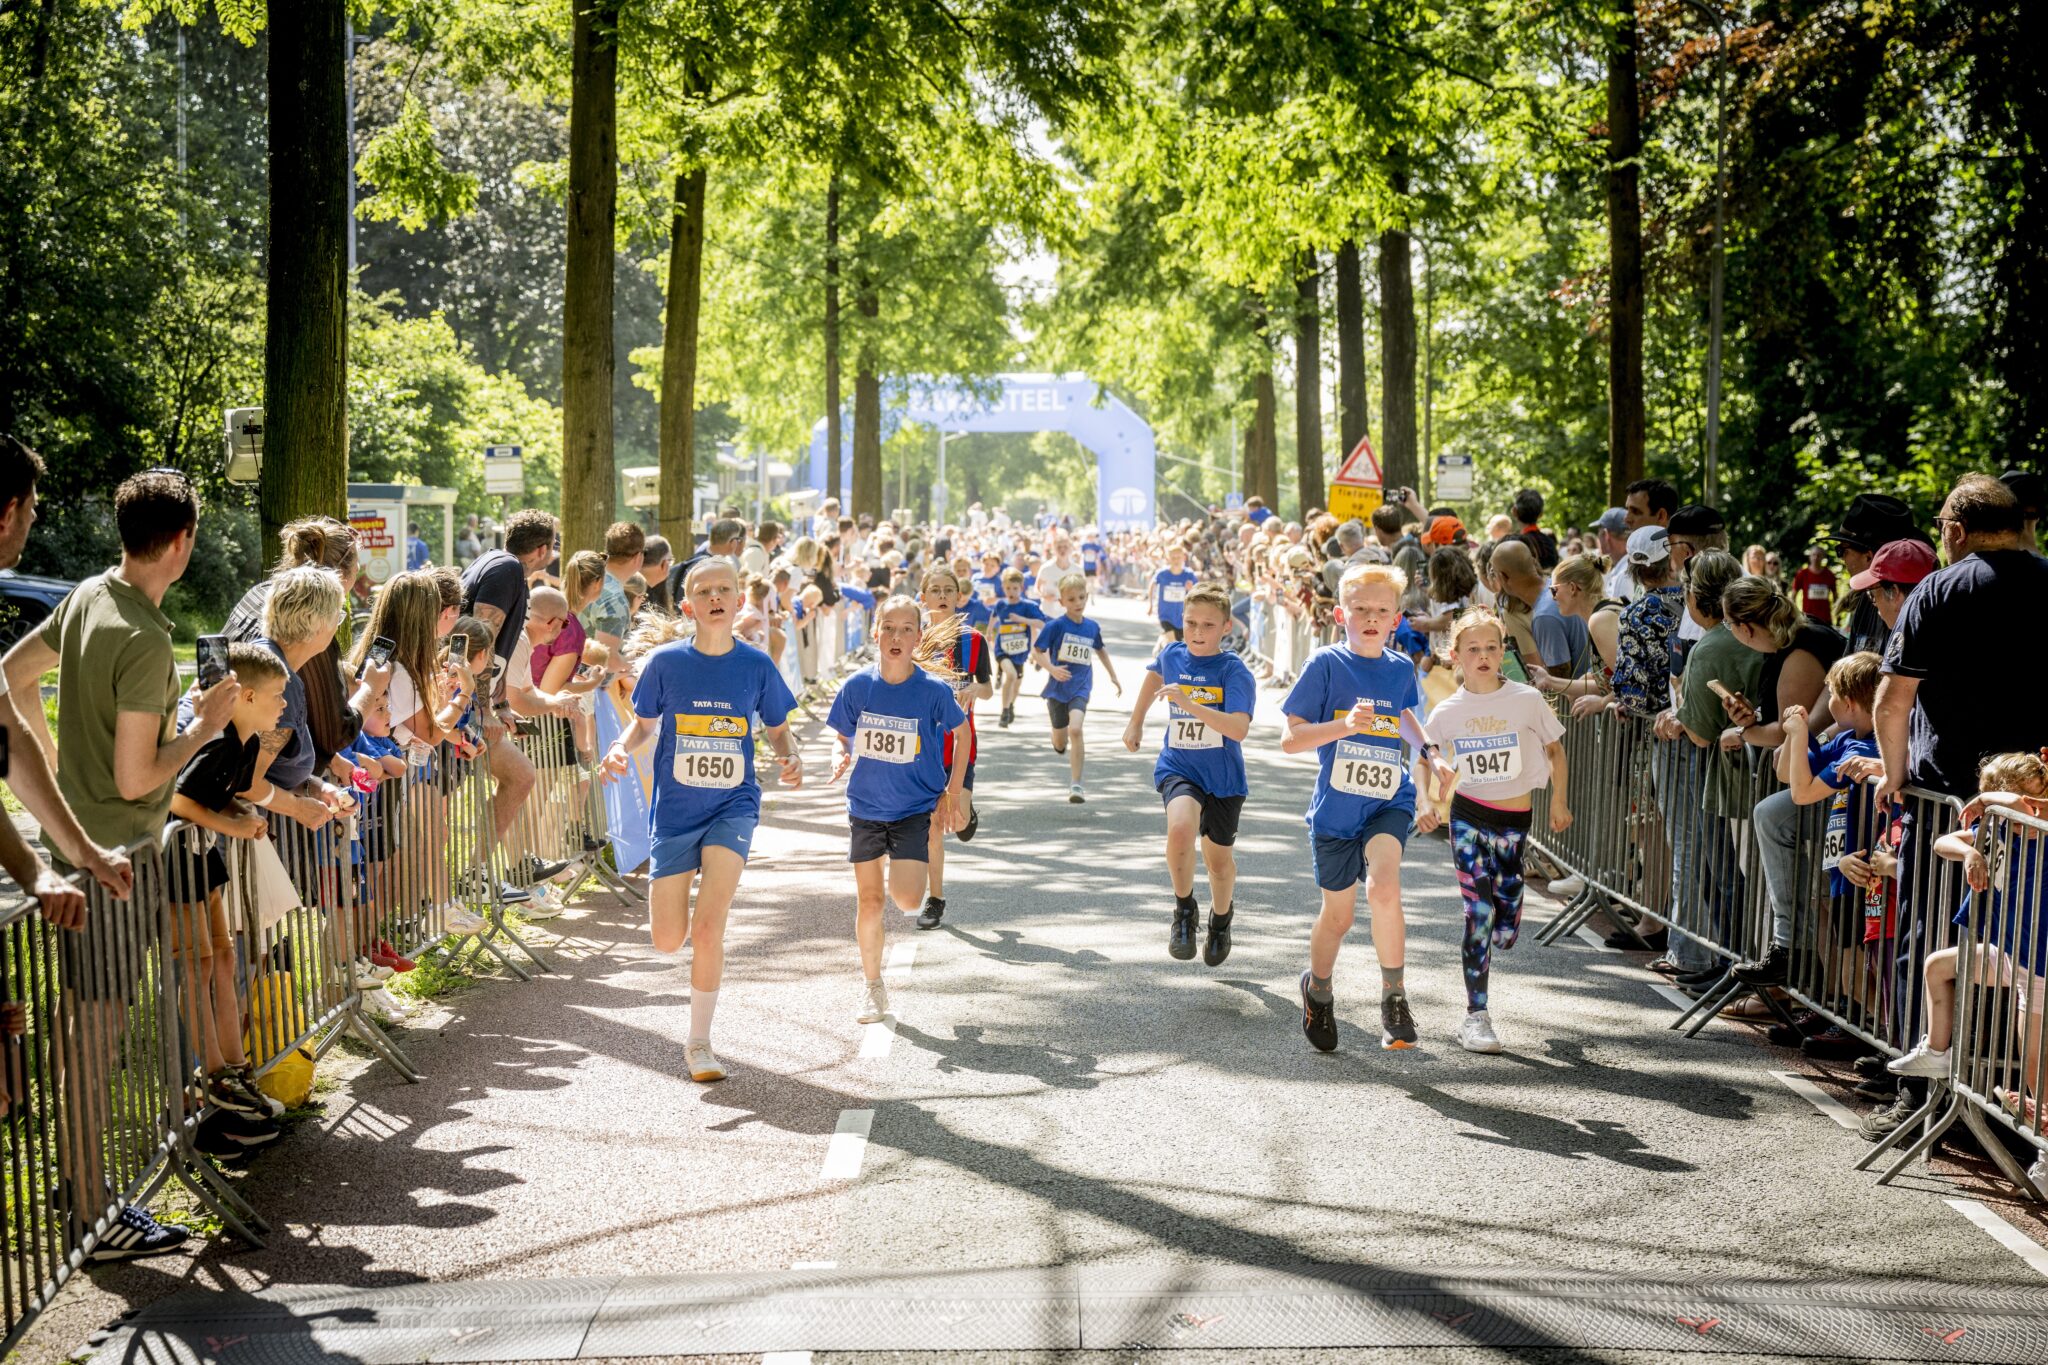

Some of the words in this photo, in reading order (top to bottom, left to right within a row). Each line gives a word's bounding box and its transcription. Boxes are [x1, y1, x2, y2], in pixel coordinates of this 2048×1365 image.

[992, 389, 1067, 412] STEEL
[1067, 645, 1089, 659] 1810
[1376, 700, 1392, 708] STEEL
[862, 715, 886, 727] TATA
[888, 719, 913, 730] STEEL
[1178, 721, 1205, 741] 747
[682, 739, 710, 749] TATA
[713, 741, 739, 751] STEEL
[864, 730, 905, 755] 1381
[1458, 740, 1485, 749] TATA
[1486, 736, 1513, 747] STEEL
[1343, 744, 1371, 757] TATA
[1374, 750, 1396, 761] STEEL
[686, 754, 734, 779] 1650
[1466, 750, 1510, 775] 1947
[1345, 761, 1393, 789] 1633
[1343, 785, 1356, 793] Tata
[1358, 788, 1374, 796] Steel
[1376, 790, 1388, 798] Run
[1830, 817, 1846, 828] STEE
